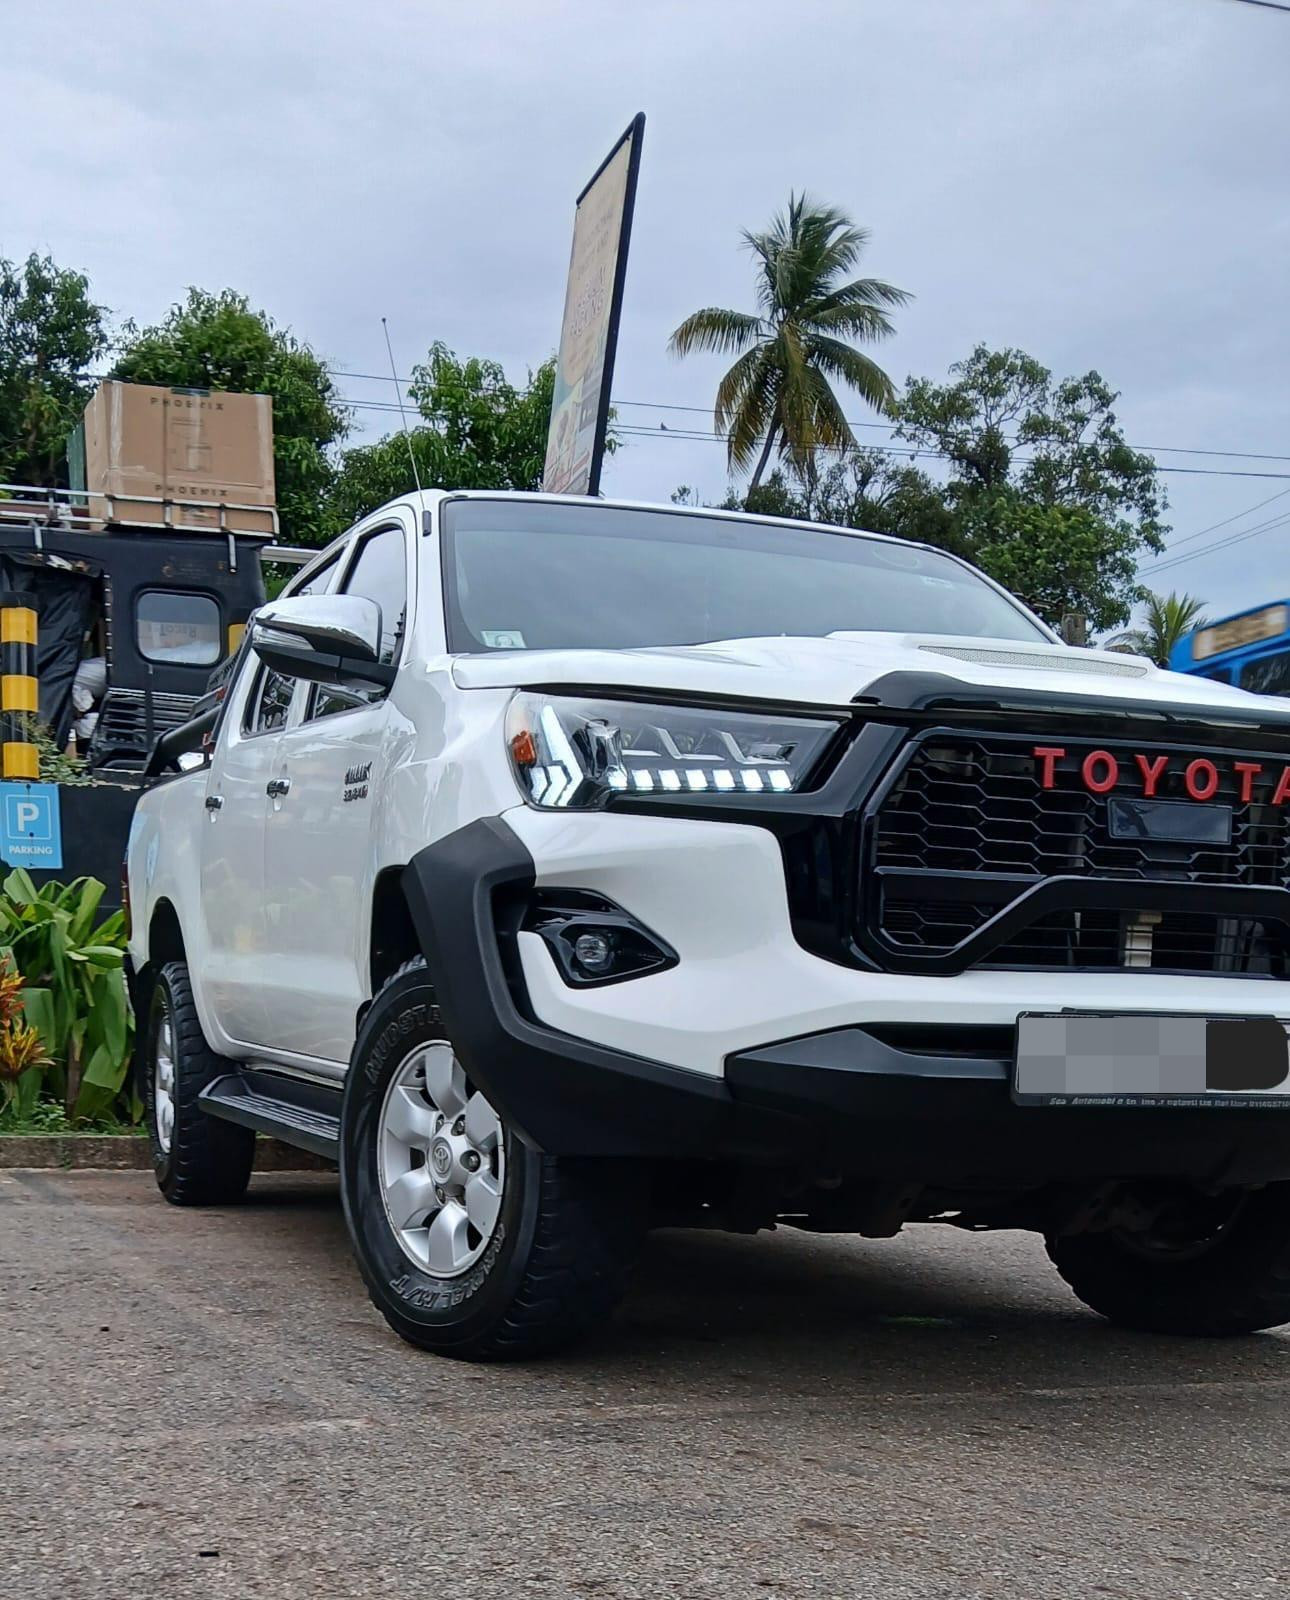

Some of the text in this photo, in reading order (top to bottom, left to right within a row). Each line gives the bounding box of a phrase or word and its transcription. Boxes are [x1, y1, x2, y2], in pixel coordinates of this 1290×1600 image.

[155, 484, 228, 497] PHOENIX
[1033, 746, 1290, 806] TOYOTA
[17, 802, 39, 832] P
[9, 845, 53, 855] PARKING
[364, 1004, 445, 1084] MUDSTA
[1071, 1097, 1124, 1105] Automobie
[389, 1274, 436, 1308] M/T
